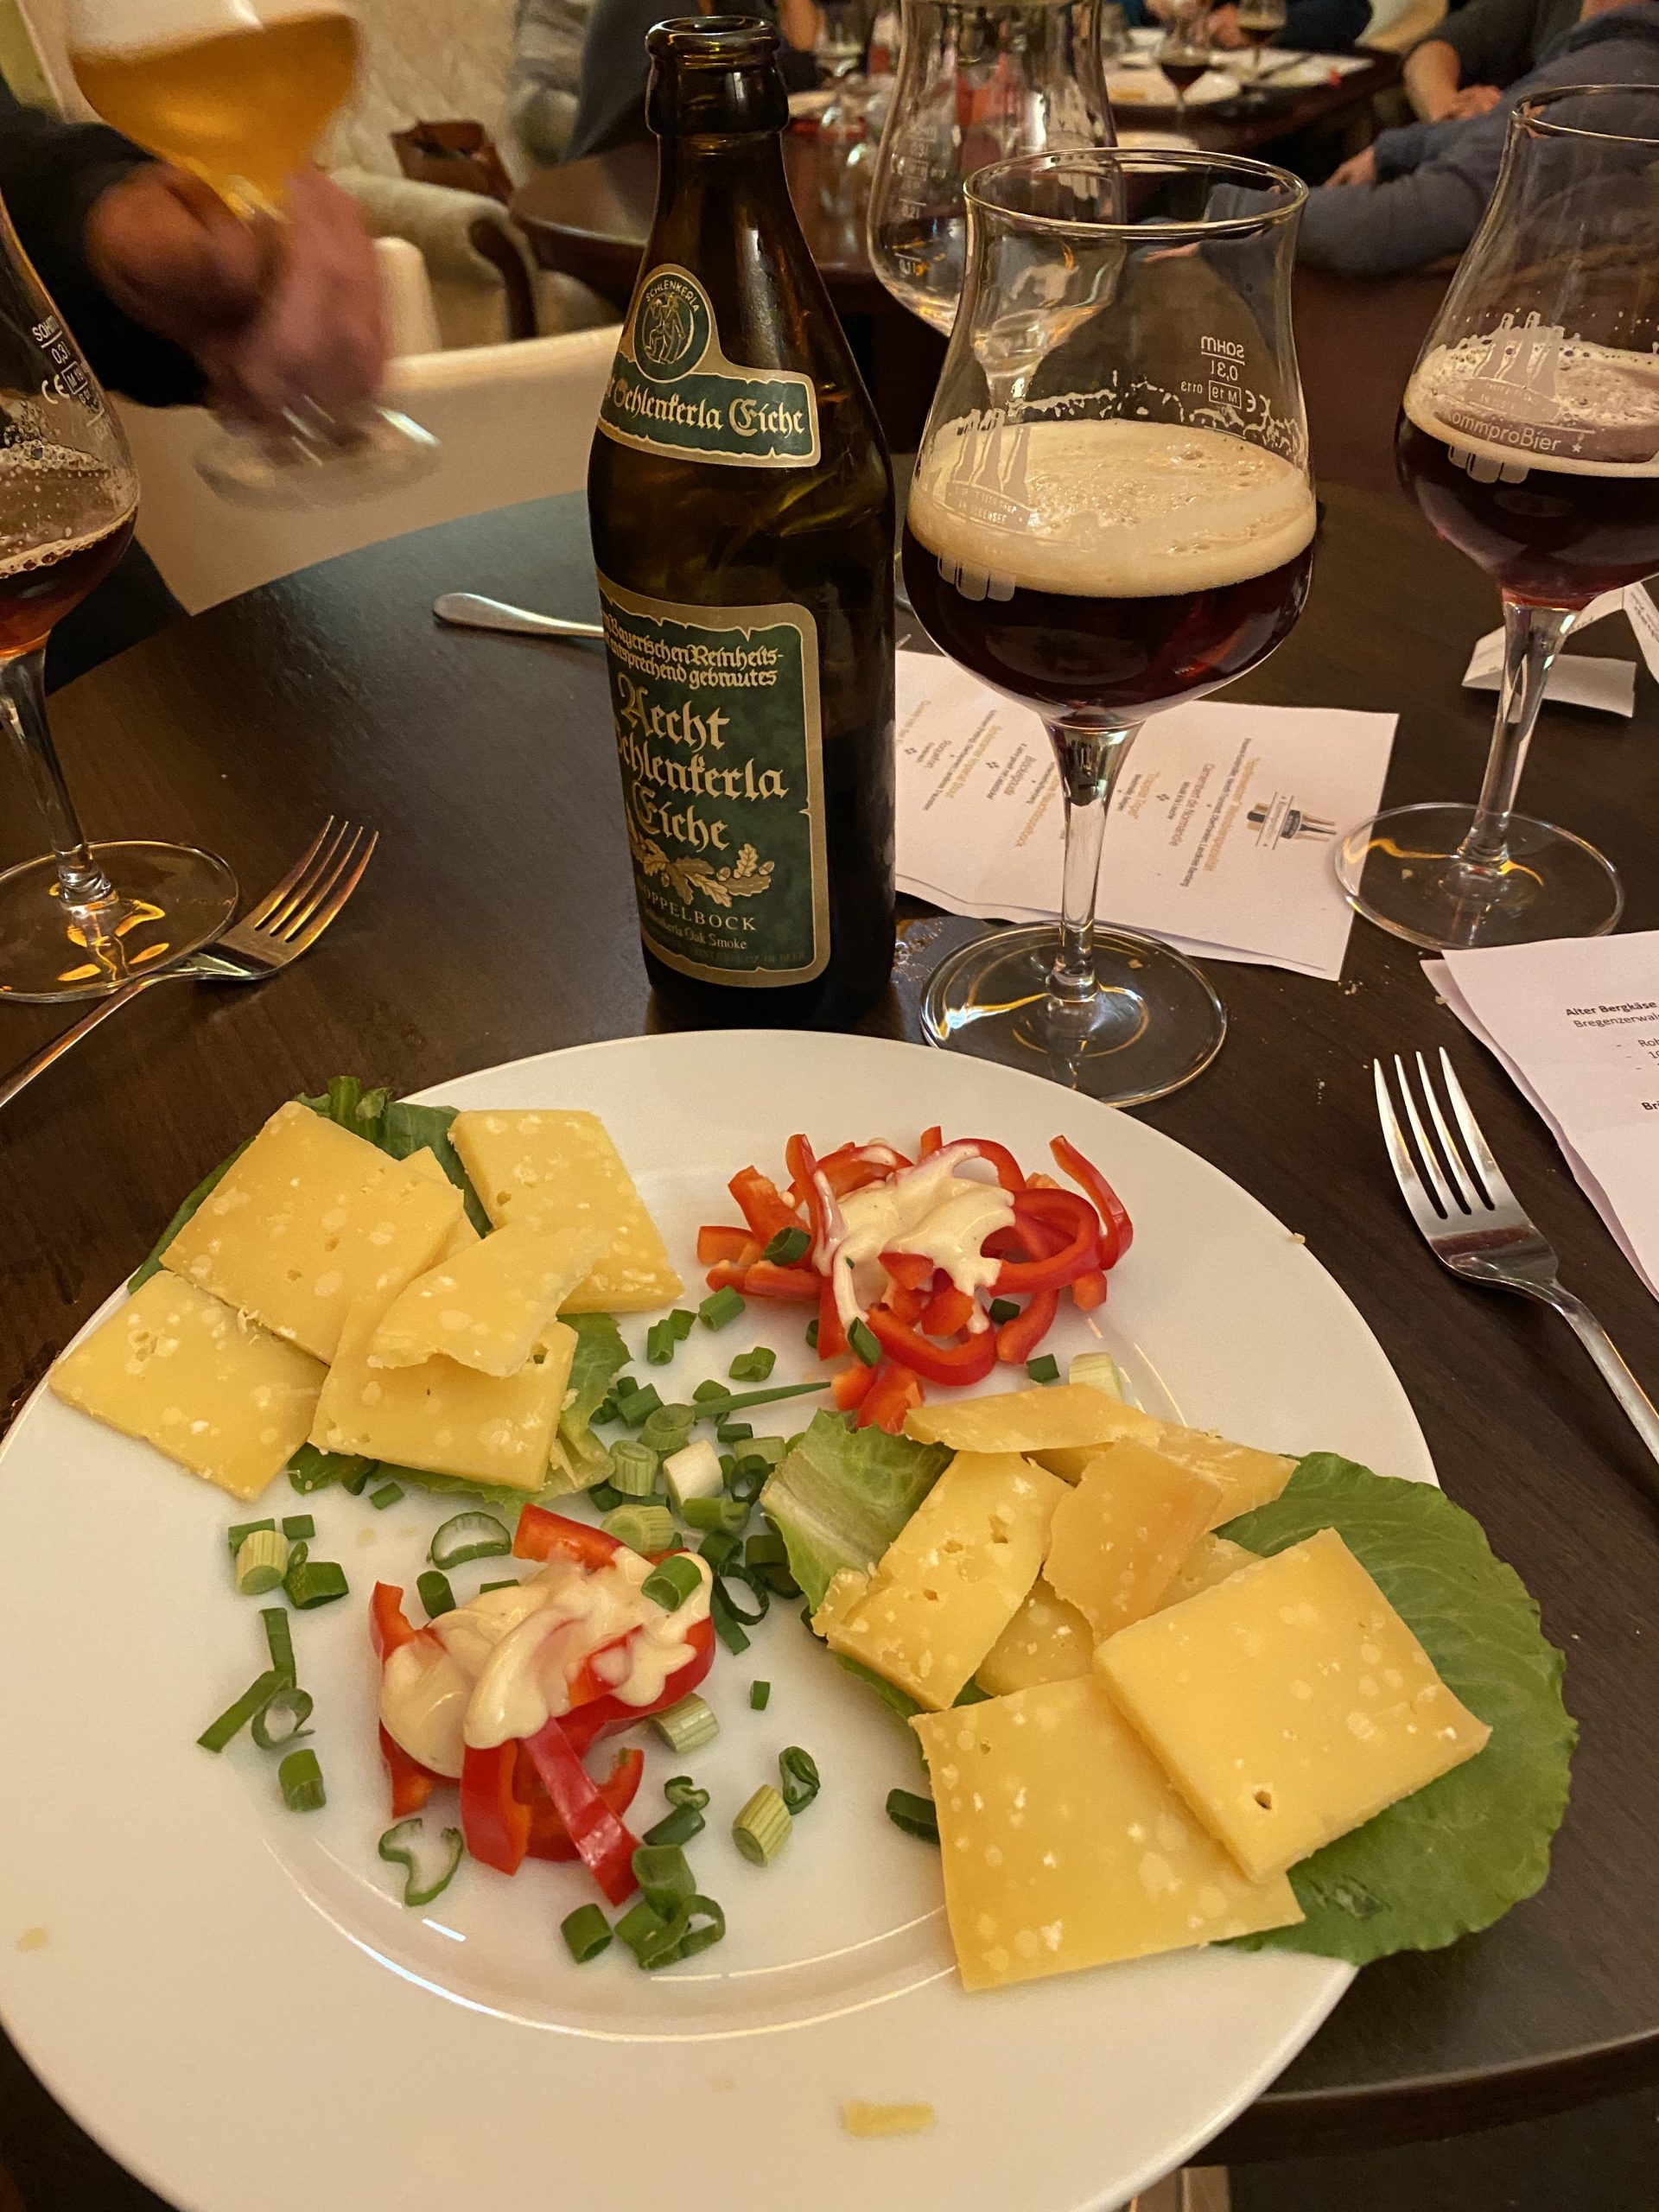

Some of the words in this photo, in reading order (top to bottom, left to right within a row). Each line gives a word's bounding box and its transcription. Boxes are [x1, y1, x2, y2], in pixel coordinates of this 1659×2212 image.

[645, 279, 701, 314] SCHLENKERLA
[728, 398, 805, 437] Eiche
[688, 643, 785, 671] Reinheits-
[689, 667, 779, 690] gebrautes
[618, 671, 730, 753] Aecht
[616, 726, 789, 802] chlenkerla
[632, 779, 730, 854] Eiche
[1168, 808, 1195, 846] Normandie
[709, 932, 747, 950] Smoke
[1566, 1007, 1596, 1016] Alter
[1599, 1001, 1658, 1014] Bergkäse
